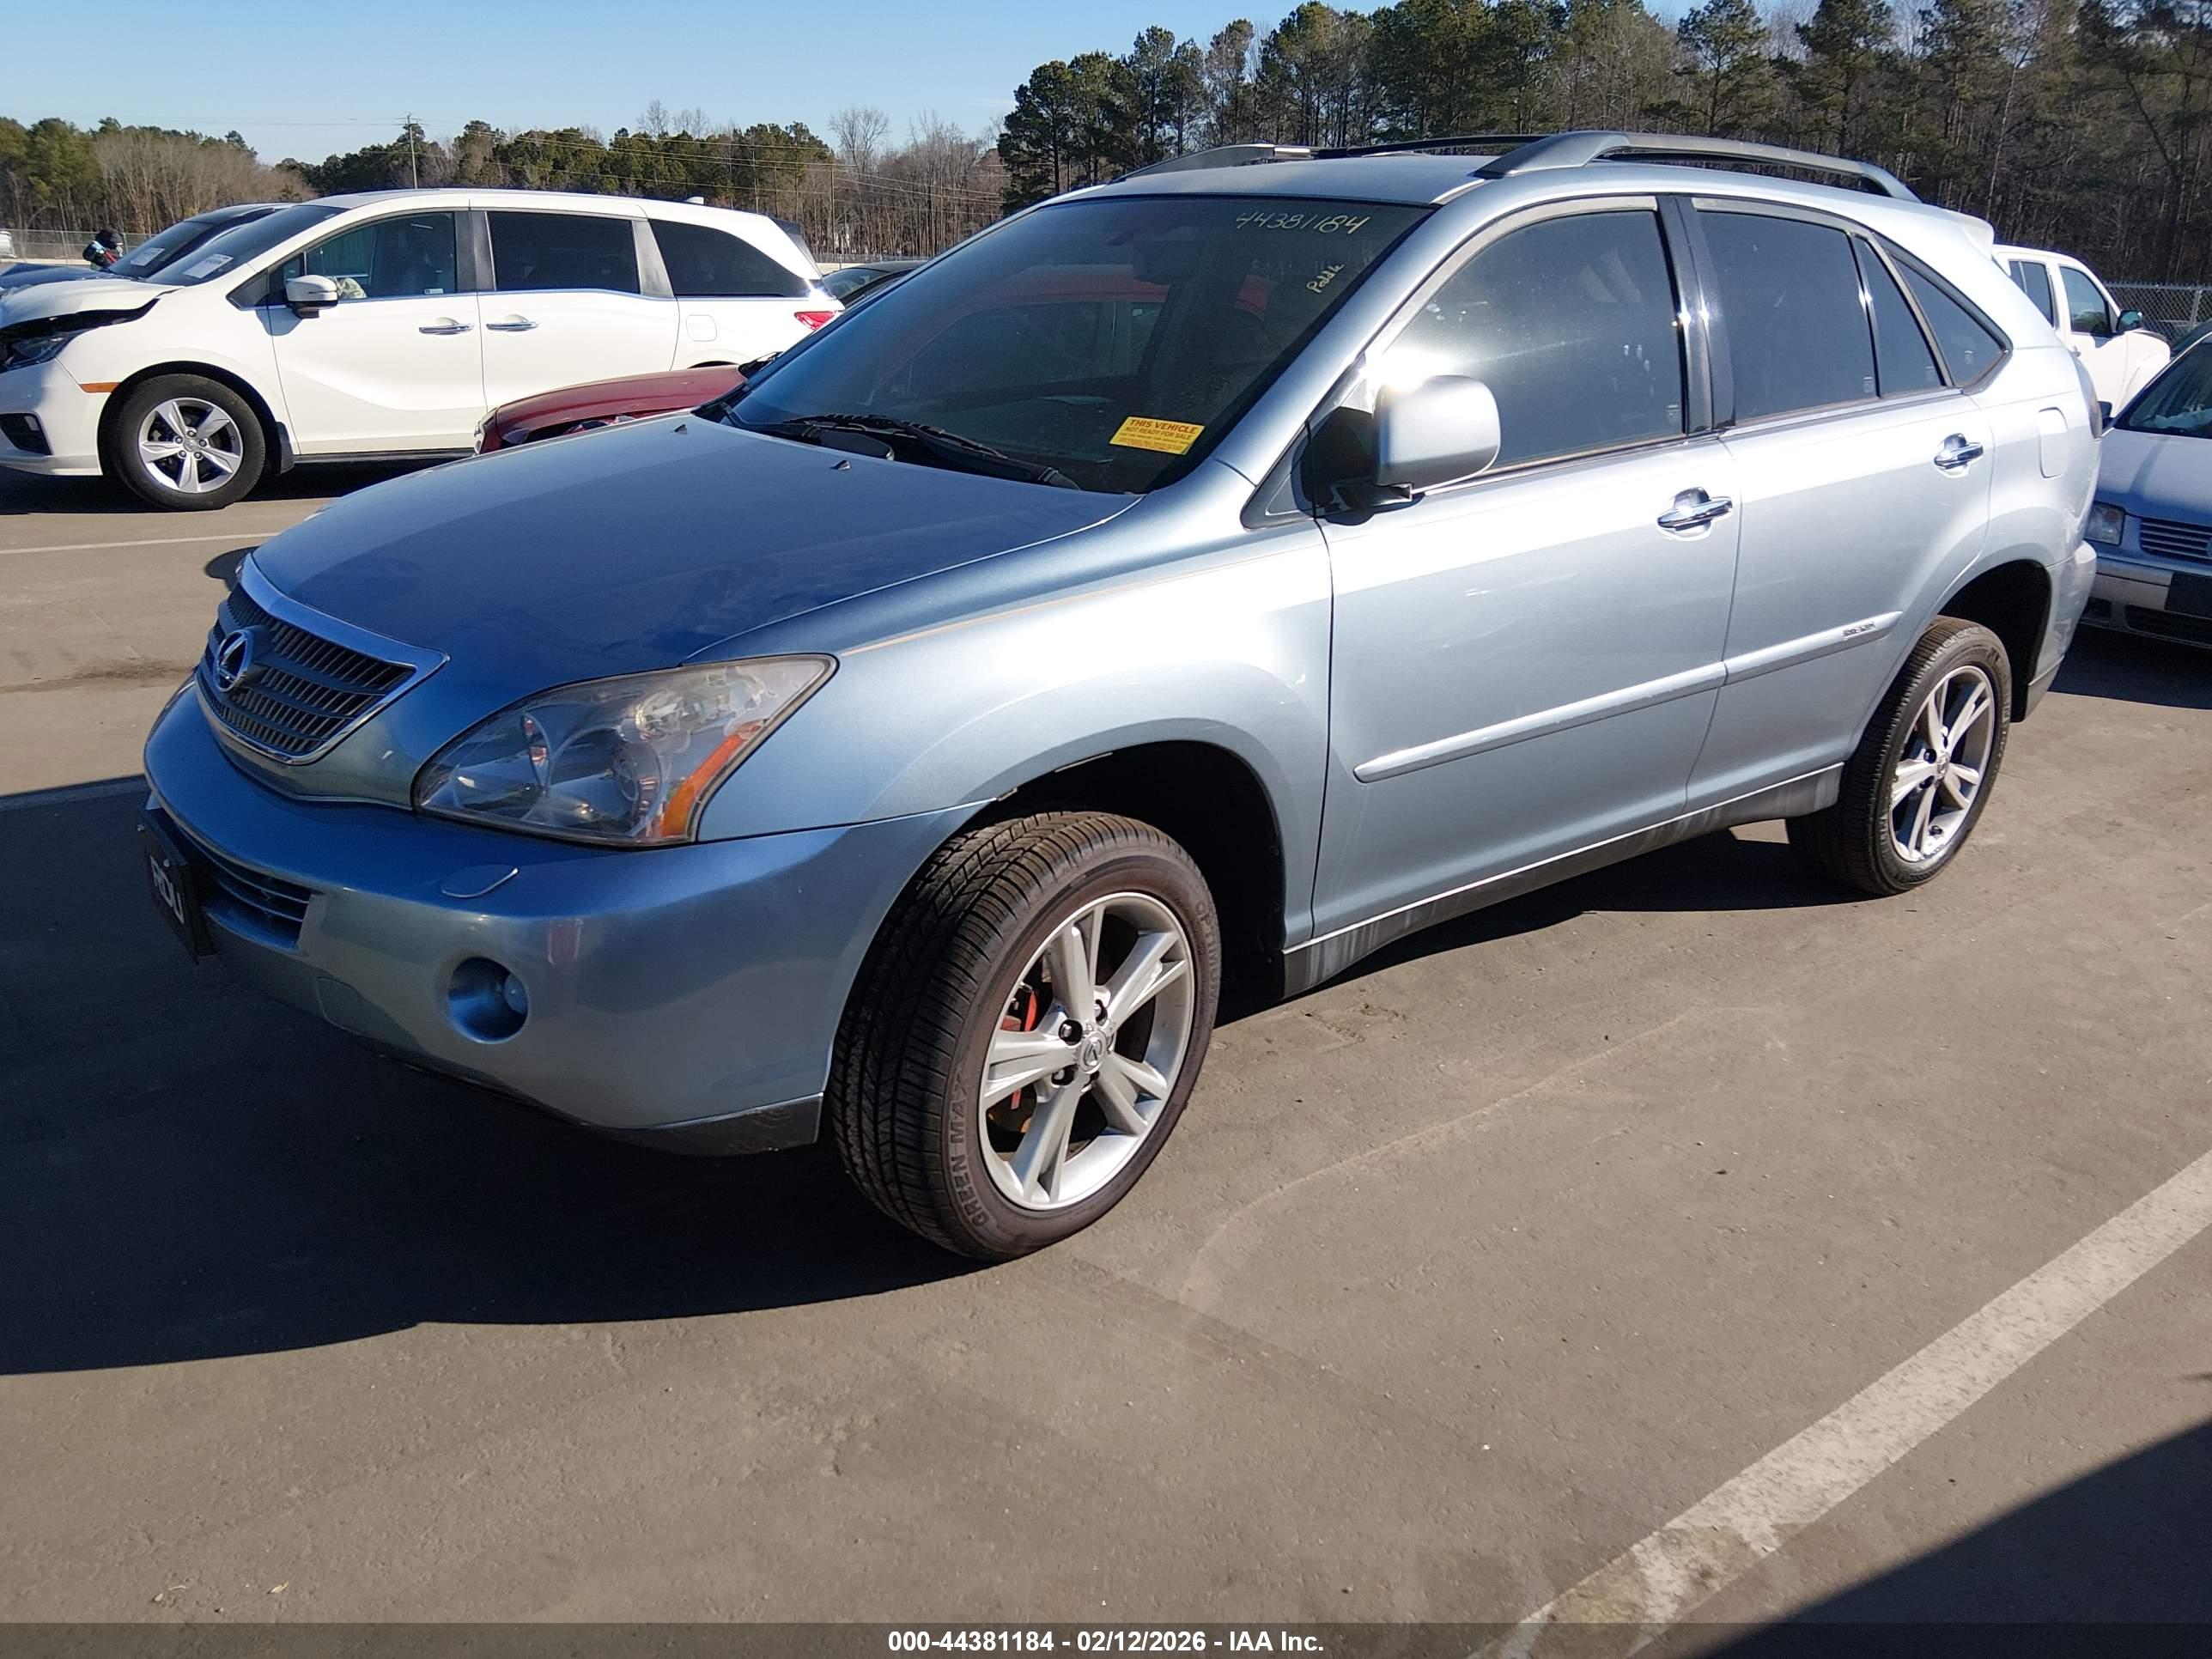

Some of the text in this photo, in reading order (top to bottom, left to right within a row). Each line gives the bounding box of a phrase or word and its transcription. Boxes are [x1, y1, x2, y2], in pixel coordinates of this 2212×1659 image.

[1236, 211, 1371, 234] 44381184
[1130, 419, 1199, 434] THIS VEHICLE
[951, 1153, 988, 1227] GREEN
